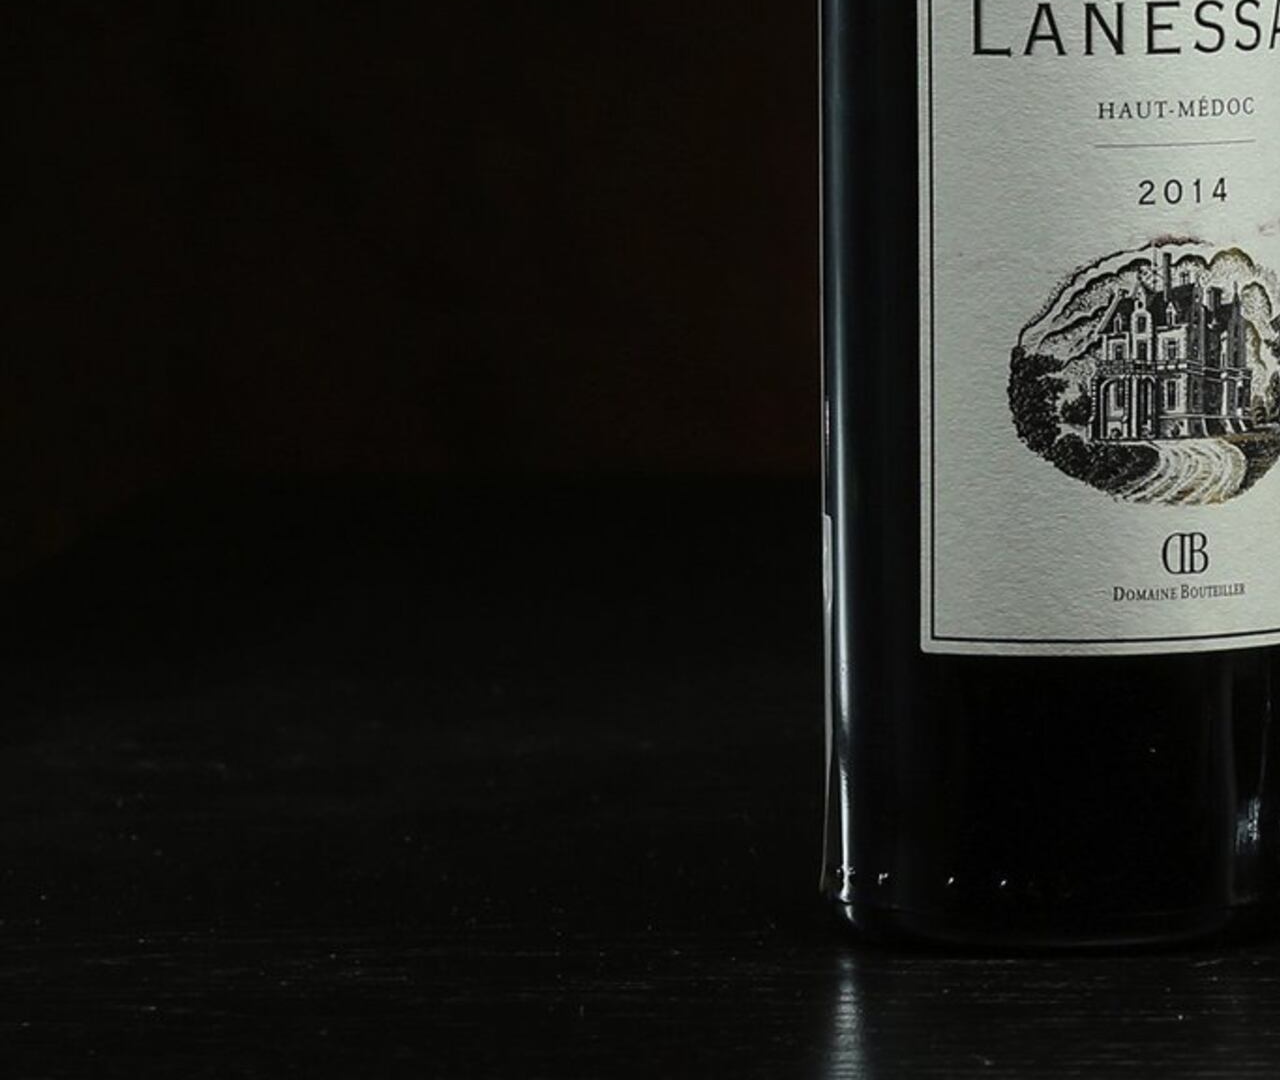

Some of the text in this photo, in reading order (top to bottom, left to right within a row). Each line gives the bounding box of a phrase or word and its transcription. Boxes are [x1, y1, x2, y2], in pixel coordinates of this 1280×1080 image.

[1098, 95, 1255, 119] HAUT-MÉDOC
[1138, 177, 1229, 205] 2014
[1113, 583, 1246, 601] DOMAINE BOUTEILLER
